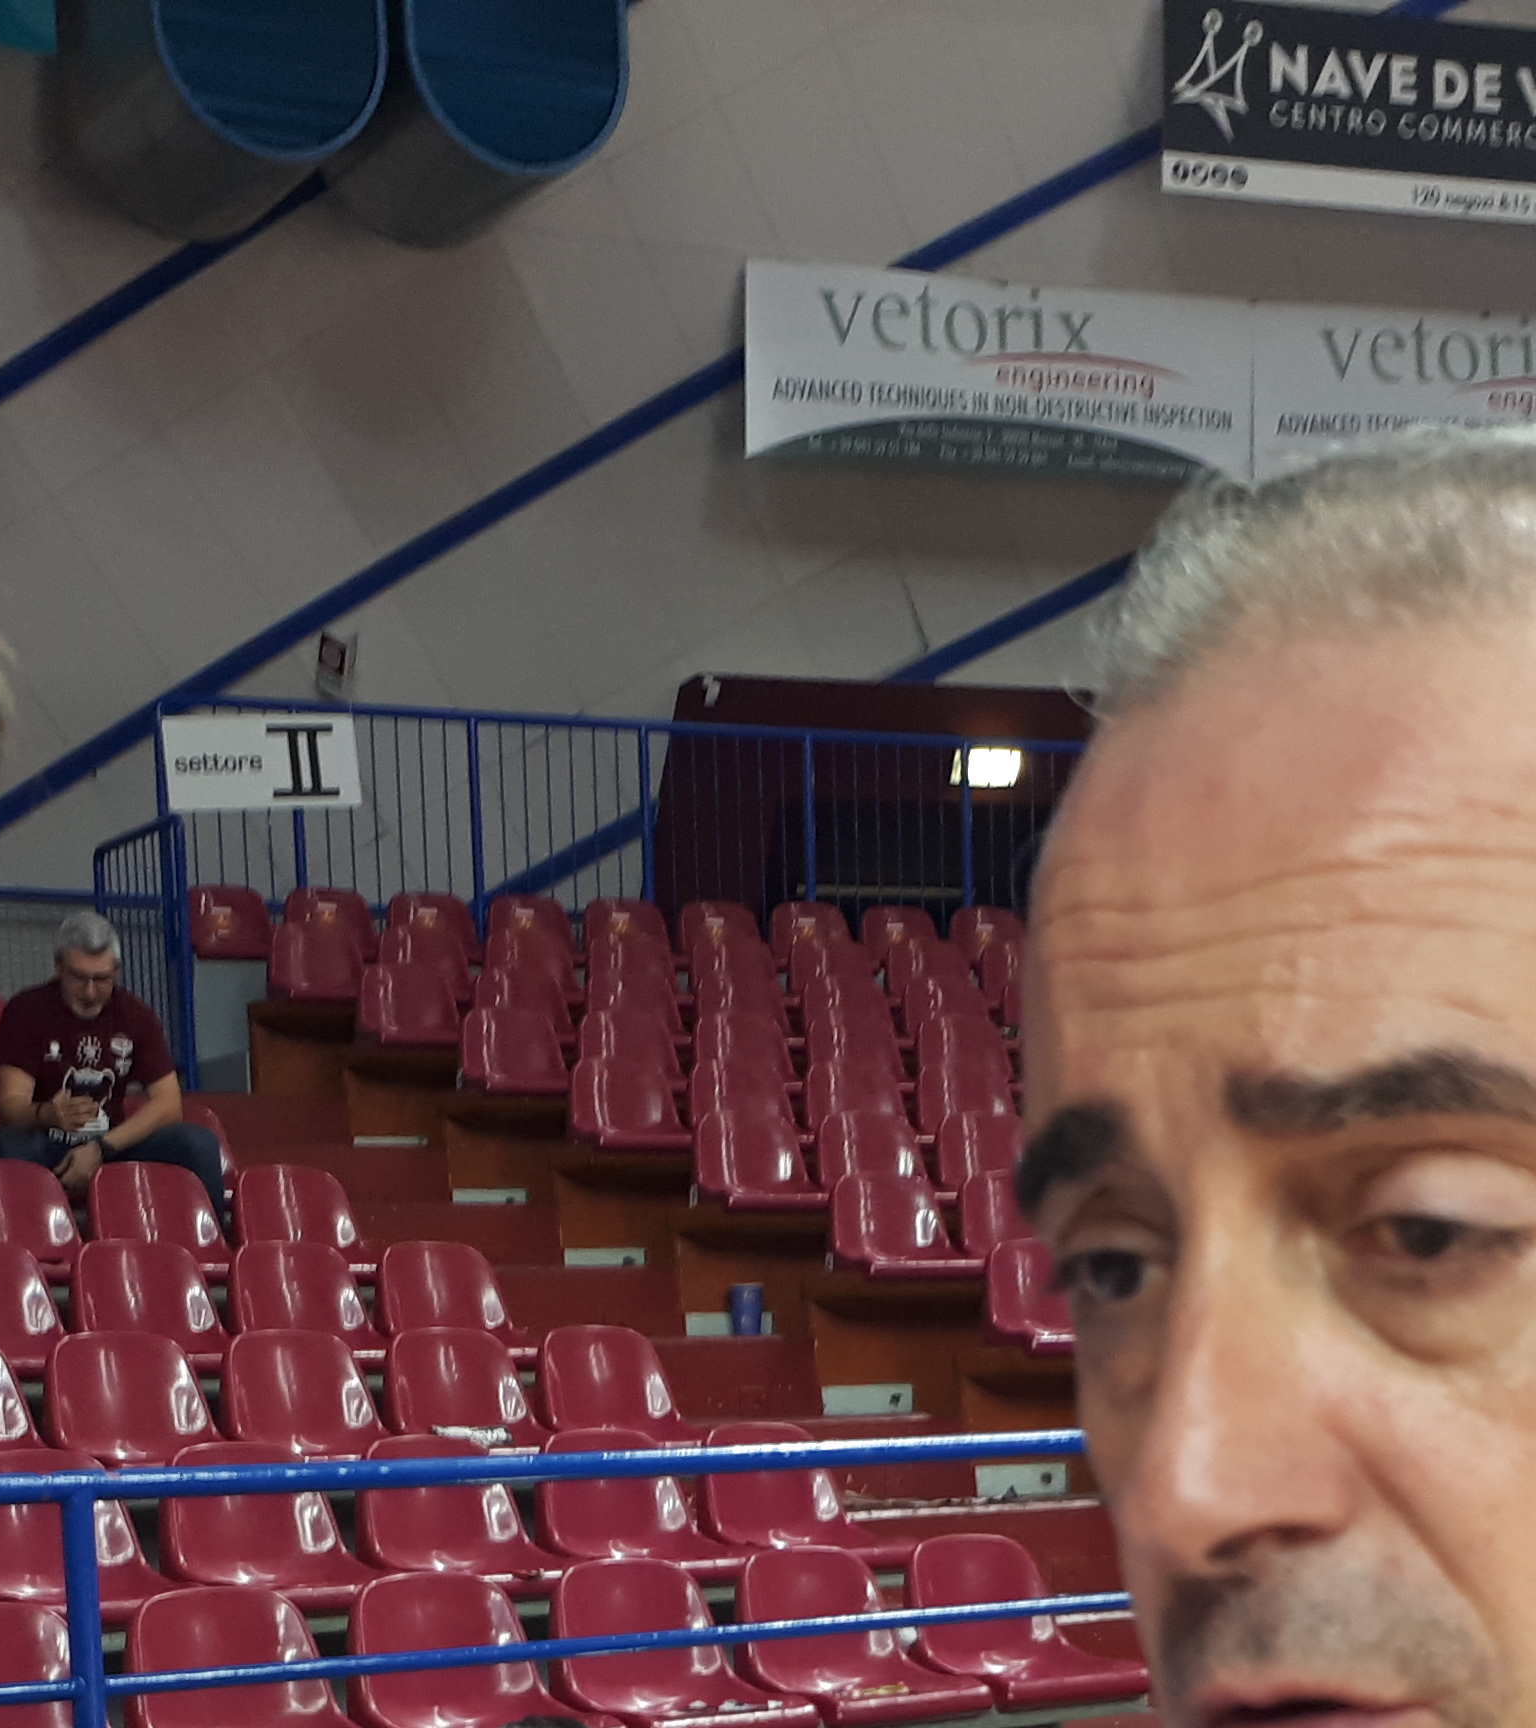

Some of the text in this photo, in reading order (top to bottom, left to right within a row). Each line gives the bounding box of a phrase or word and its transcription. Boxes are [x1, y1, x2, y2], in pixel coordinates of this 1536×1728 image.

[1268, 41, 1417, 107] NAVE
[1432, 57, 1503, 114] DE
[1268, 100, 1388, 137] CENTRO
[772, 376, 862, 406] ADVANCED
[869, 381, 968, 411] TECHNIQUES
[973, 390, 989, 413] IN
[1143, 403, 1233, 431] INSPECTION
[996, 364, 1155, 399] engineering
[175, 722, 340, 798] settore II
